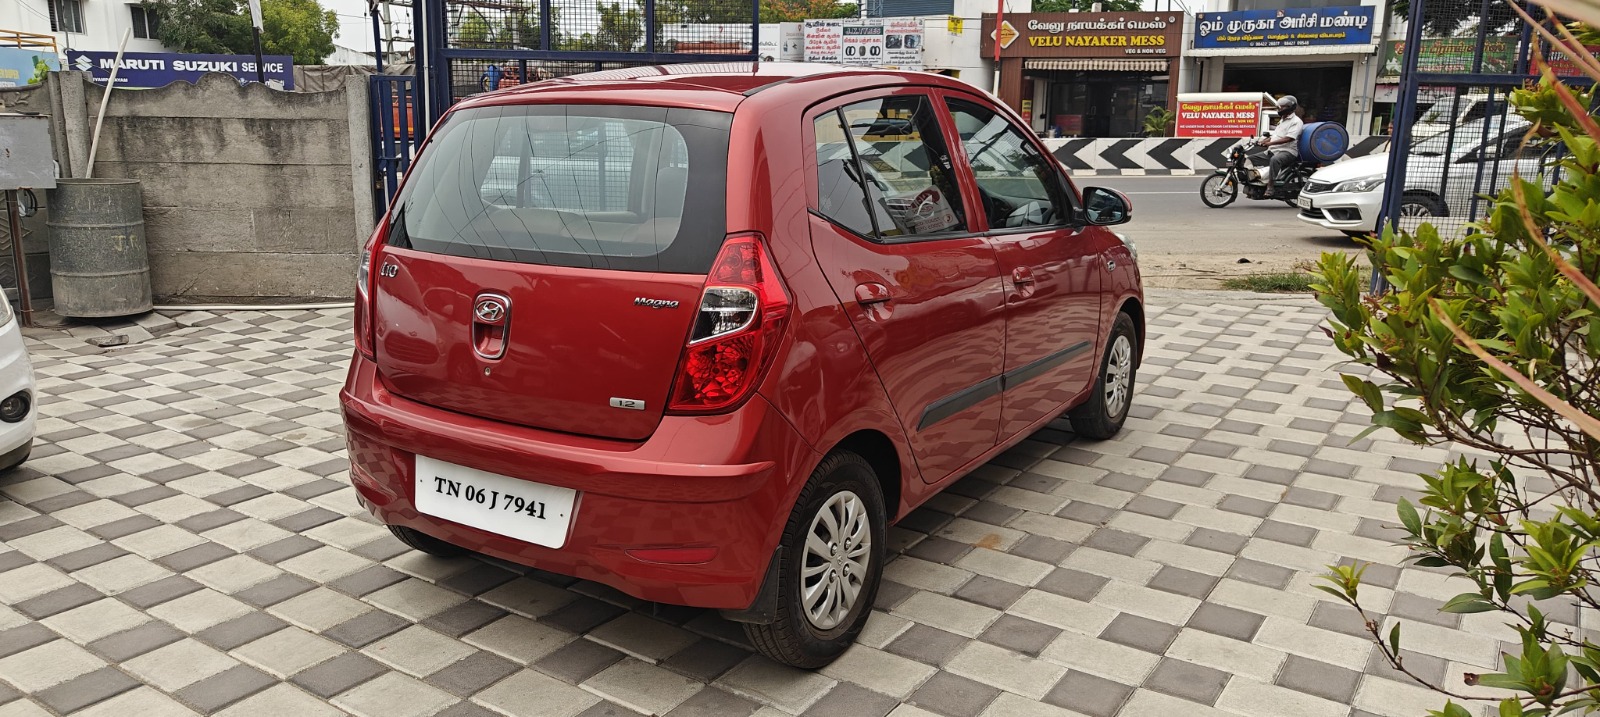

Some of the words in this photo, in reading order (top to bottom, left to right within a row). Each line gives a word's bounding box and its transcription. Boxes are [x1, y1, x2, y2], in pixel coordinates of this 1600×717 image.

[1027, 18, 1065, 33] வேலு
[1066, 17, 1124, 32] நாயக்கர்
[1127, 16, 1167, 30] மெஸ்
[1199, 16, 1223, 37] ஓம்
[1227, 18, 1276, 33] முருகா
[1279, 12, 1318, 29] அரிசி
[1320, 11, 1368, 29] மண்டி
[1028, 36, 1063, 47] VELU
[1065, 35, 1127, 47] NAYAKER
[1130, 34, 1165, 46] MESS
[99, 58, 165, 70] MARUTI
[173, 60, 237, 72] SUZUKI
[1182, 103, 1202, 112] வேலு
[1202, 102, 1234, 111] நாயக்கர்
[1235, 102, 1255, 110] மெஸ்
[633, 297, 680, 309] Magna
[618, 400, 636, 408] 1.2
[434, 476, 461, 498] TN
[465, 485, 486, 504] 06
[488, 491, 499, 510] J
[503, 494, 547, 520] 7941
